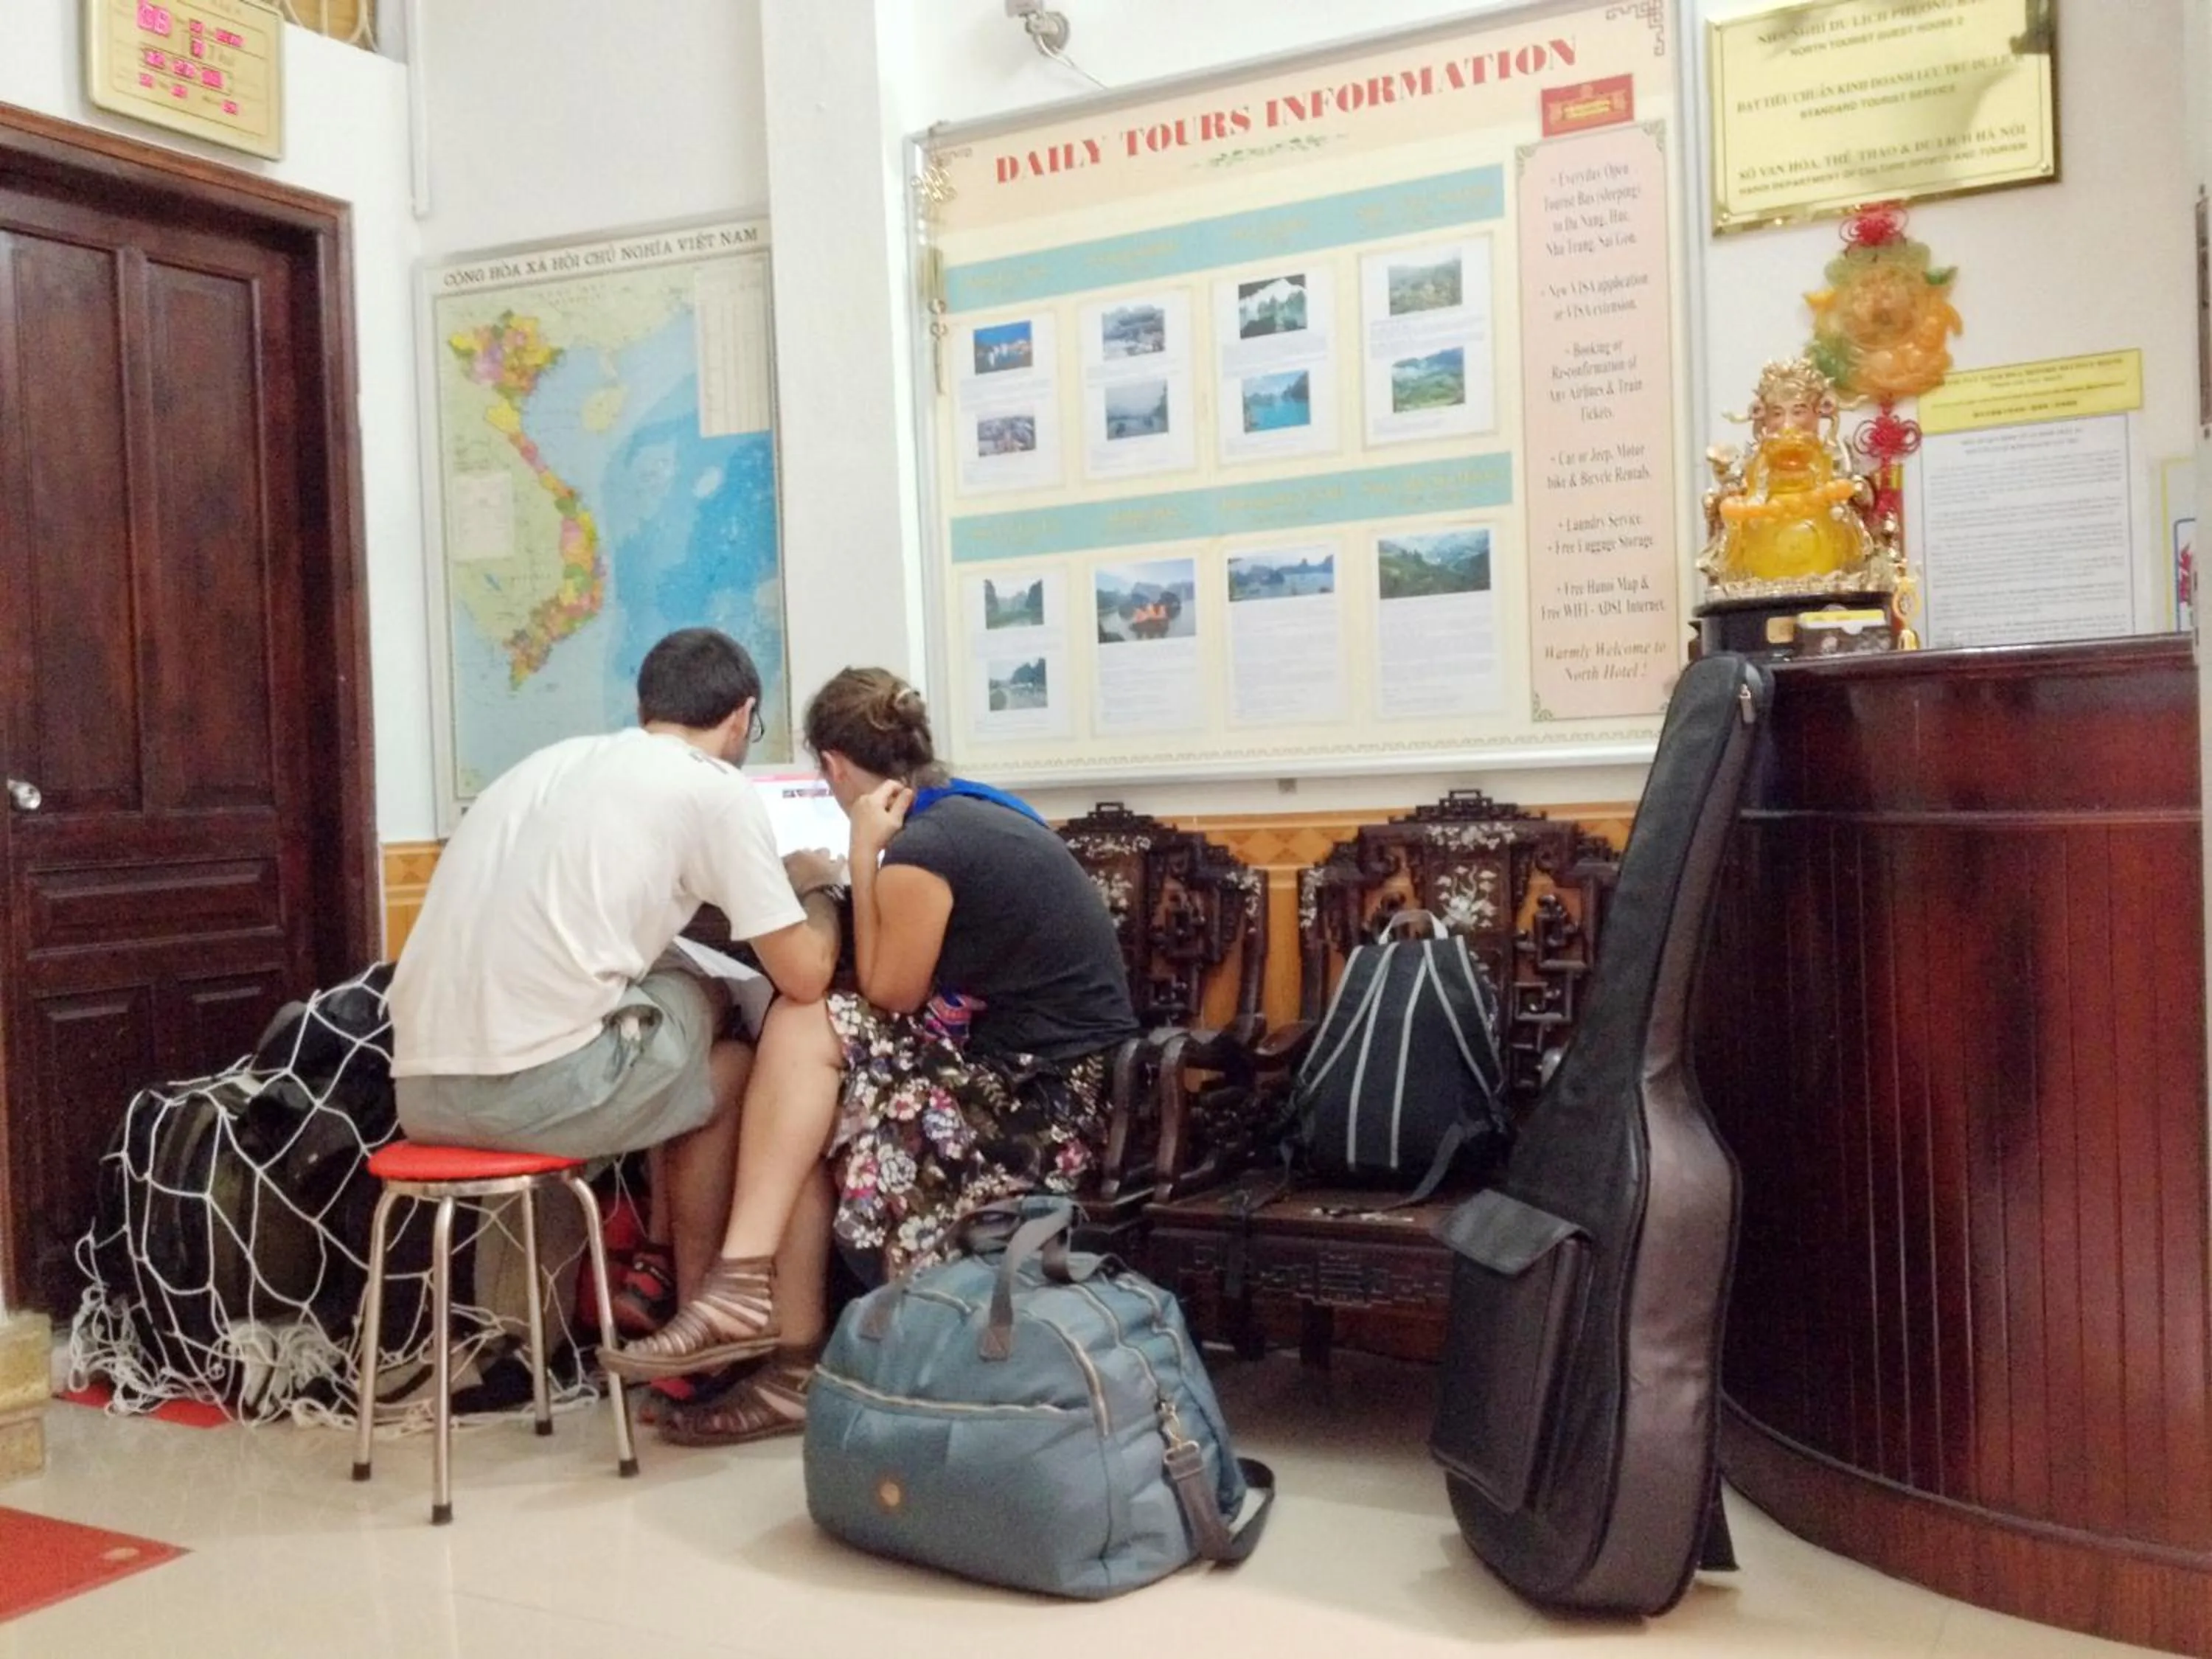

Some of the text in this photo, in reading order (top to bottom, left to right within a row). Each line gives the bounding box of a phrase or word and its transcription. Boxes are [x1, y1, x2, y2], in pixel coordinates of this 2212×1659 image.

[1837, 80, 1868, 95] KINH
[996, 135, 1107, 184] DAILY
[1120, 105, 1252, 158] TOURS
[1266, 34, 1576, 128] INFORMATION
[1559, 163, 1629, 187] Everyday Open
[720, 226, 759, 246] NAM
[1549, 274, 1649, 298] New VISA application
[1573, 340, 1624, 358] Booking or
[1547, 475, 1566, 490] bike
[1569, 472, 1578, 489] &
[1580, 469, 1613, 487] Bicycle
[1566, 512, 1606, 532] Laundry
[1555, 539, 1575, 555] Free
[1577, 537, 1618, 554] Luggage
[1565, 581, 1584, 597] Free
[1617, 575, 1640, 594] Map
[1641, 574, 1650, 591] &
[1541, 605, 1560, 622] Free
[1563, 600, 1589, 619] WIFI
[1599, 599, 1622, 616] ADSL
[1545, 639, 1667, 661] Warmly Welcome to
[1564, 665, 1600, 683] North
[1603, 661, 1640, 681] Hotel
